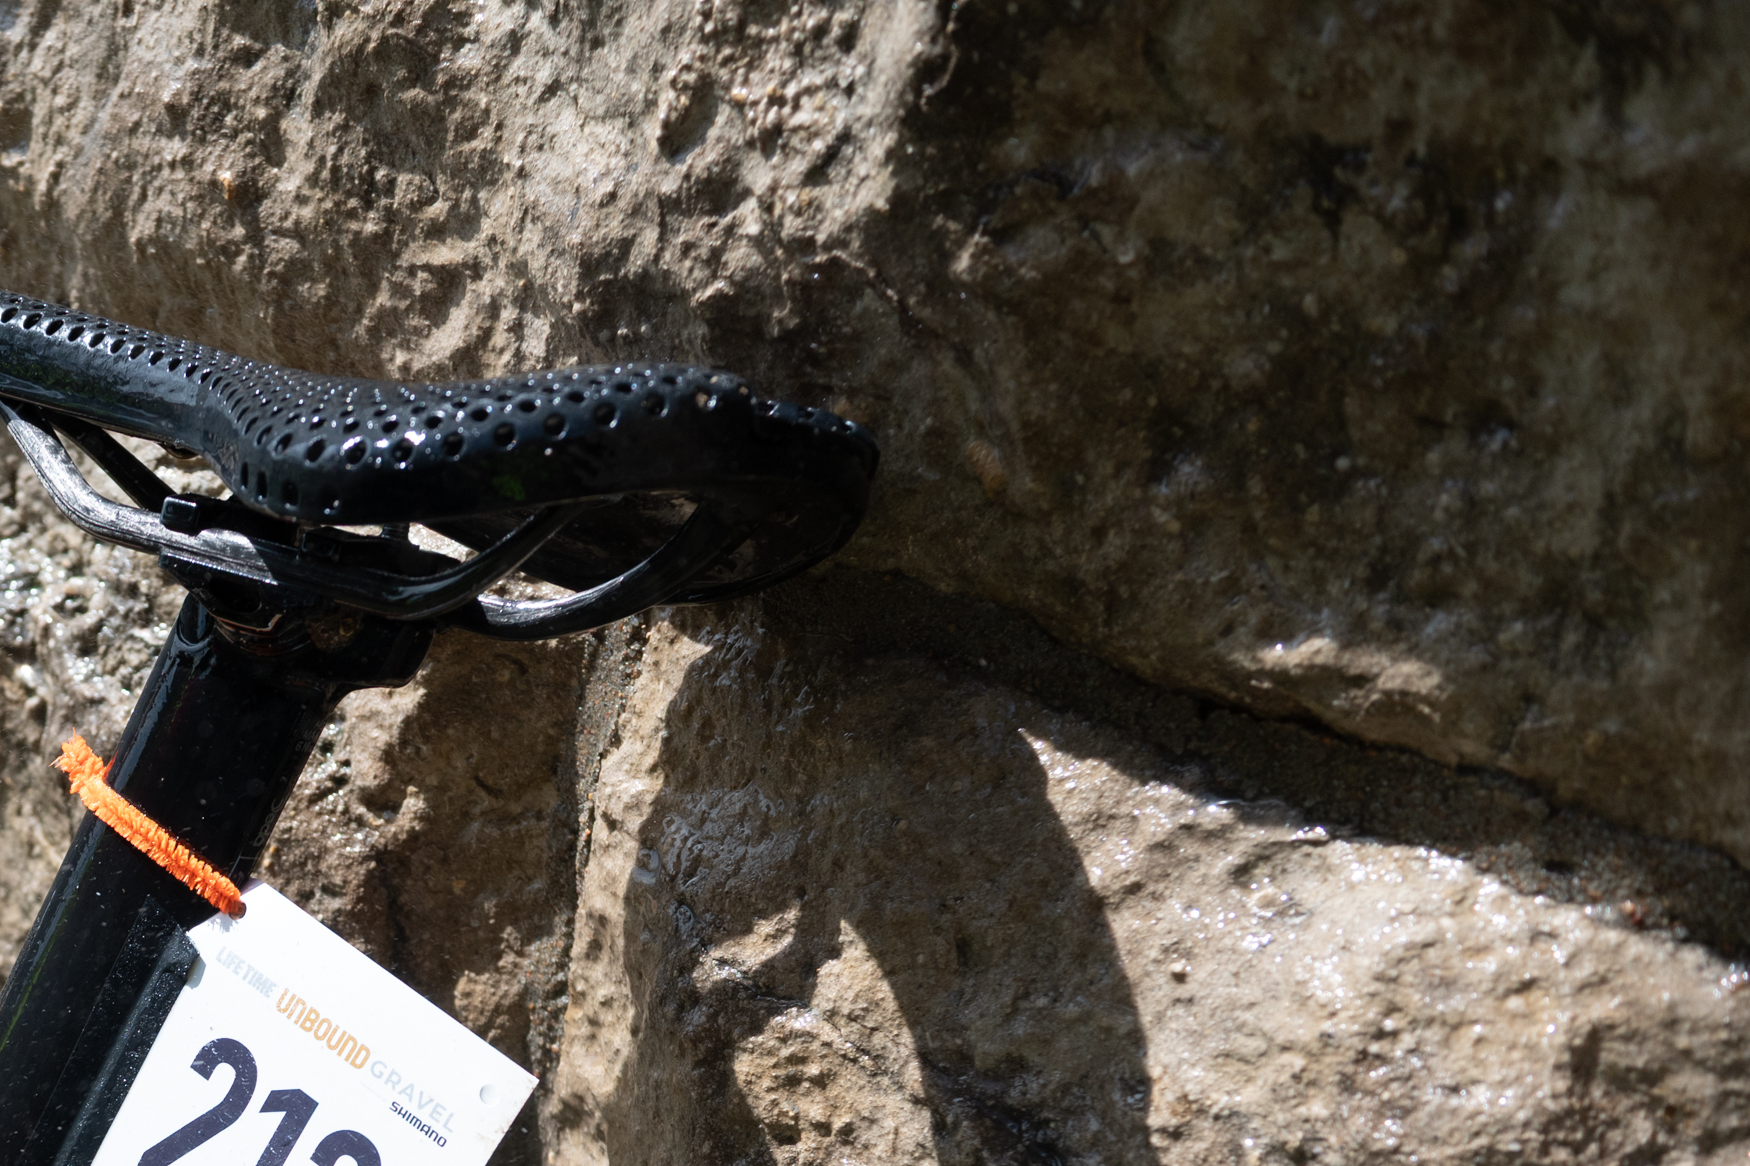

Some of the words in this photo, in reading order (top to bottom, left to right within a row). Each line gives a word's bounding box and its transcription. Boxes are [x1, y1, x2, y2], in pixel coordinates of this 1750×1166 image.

[276, 989, 371, 1070] UNBOUND
[370, 1060, 454, 1133] GRAVEL
[389, 1101, 447, 1148] SHIMANO
